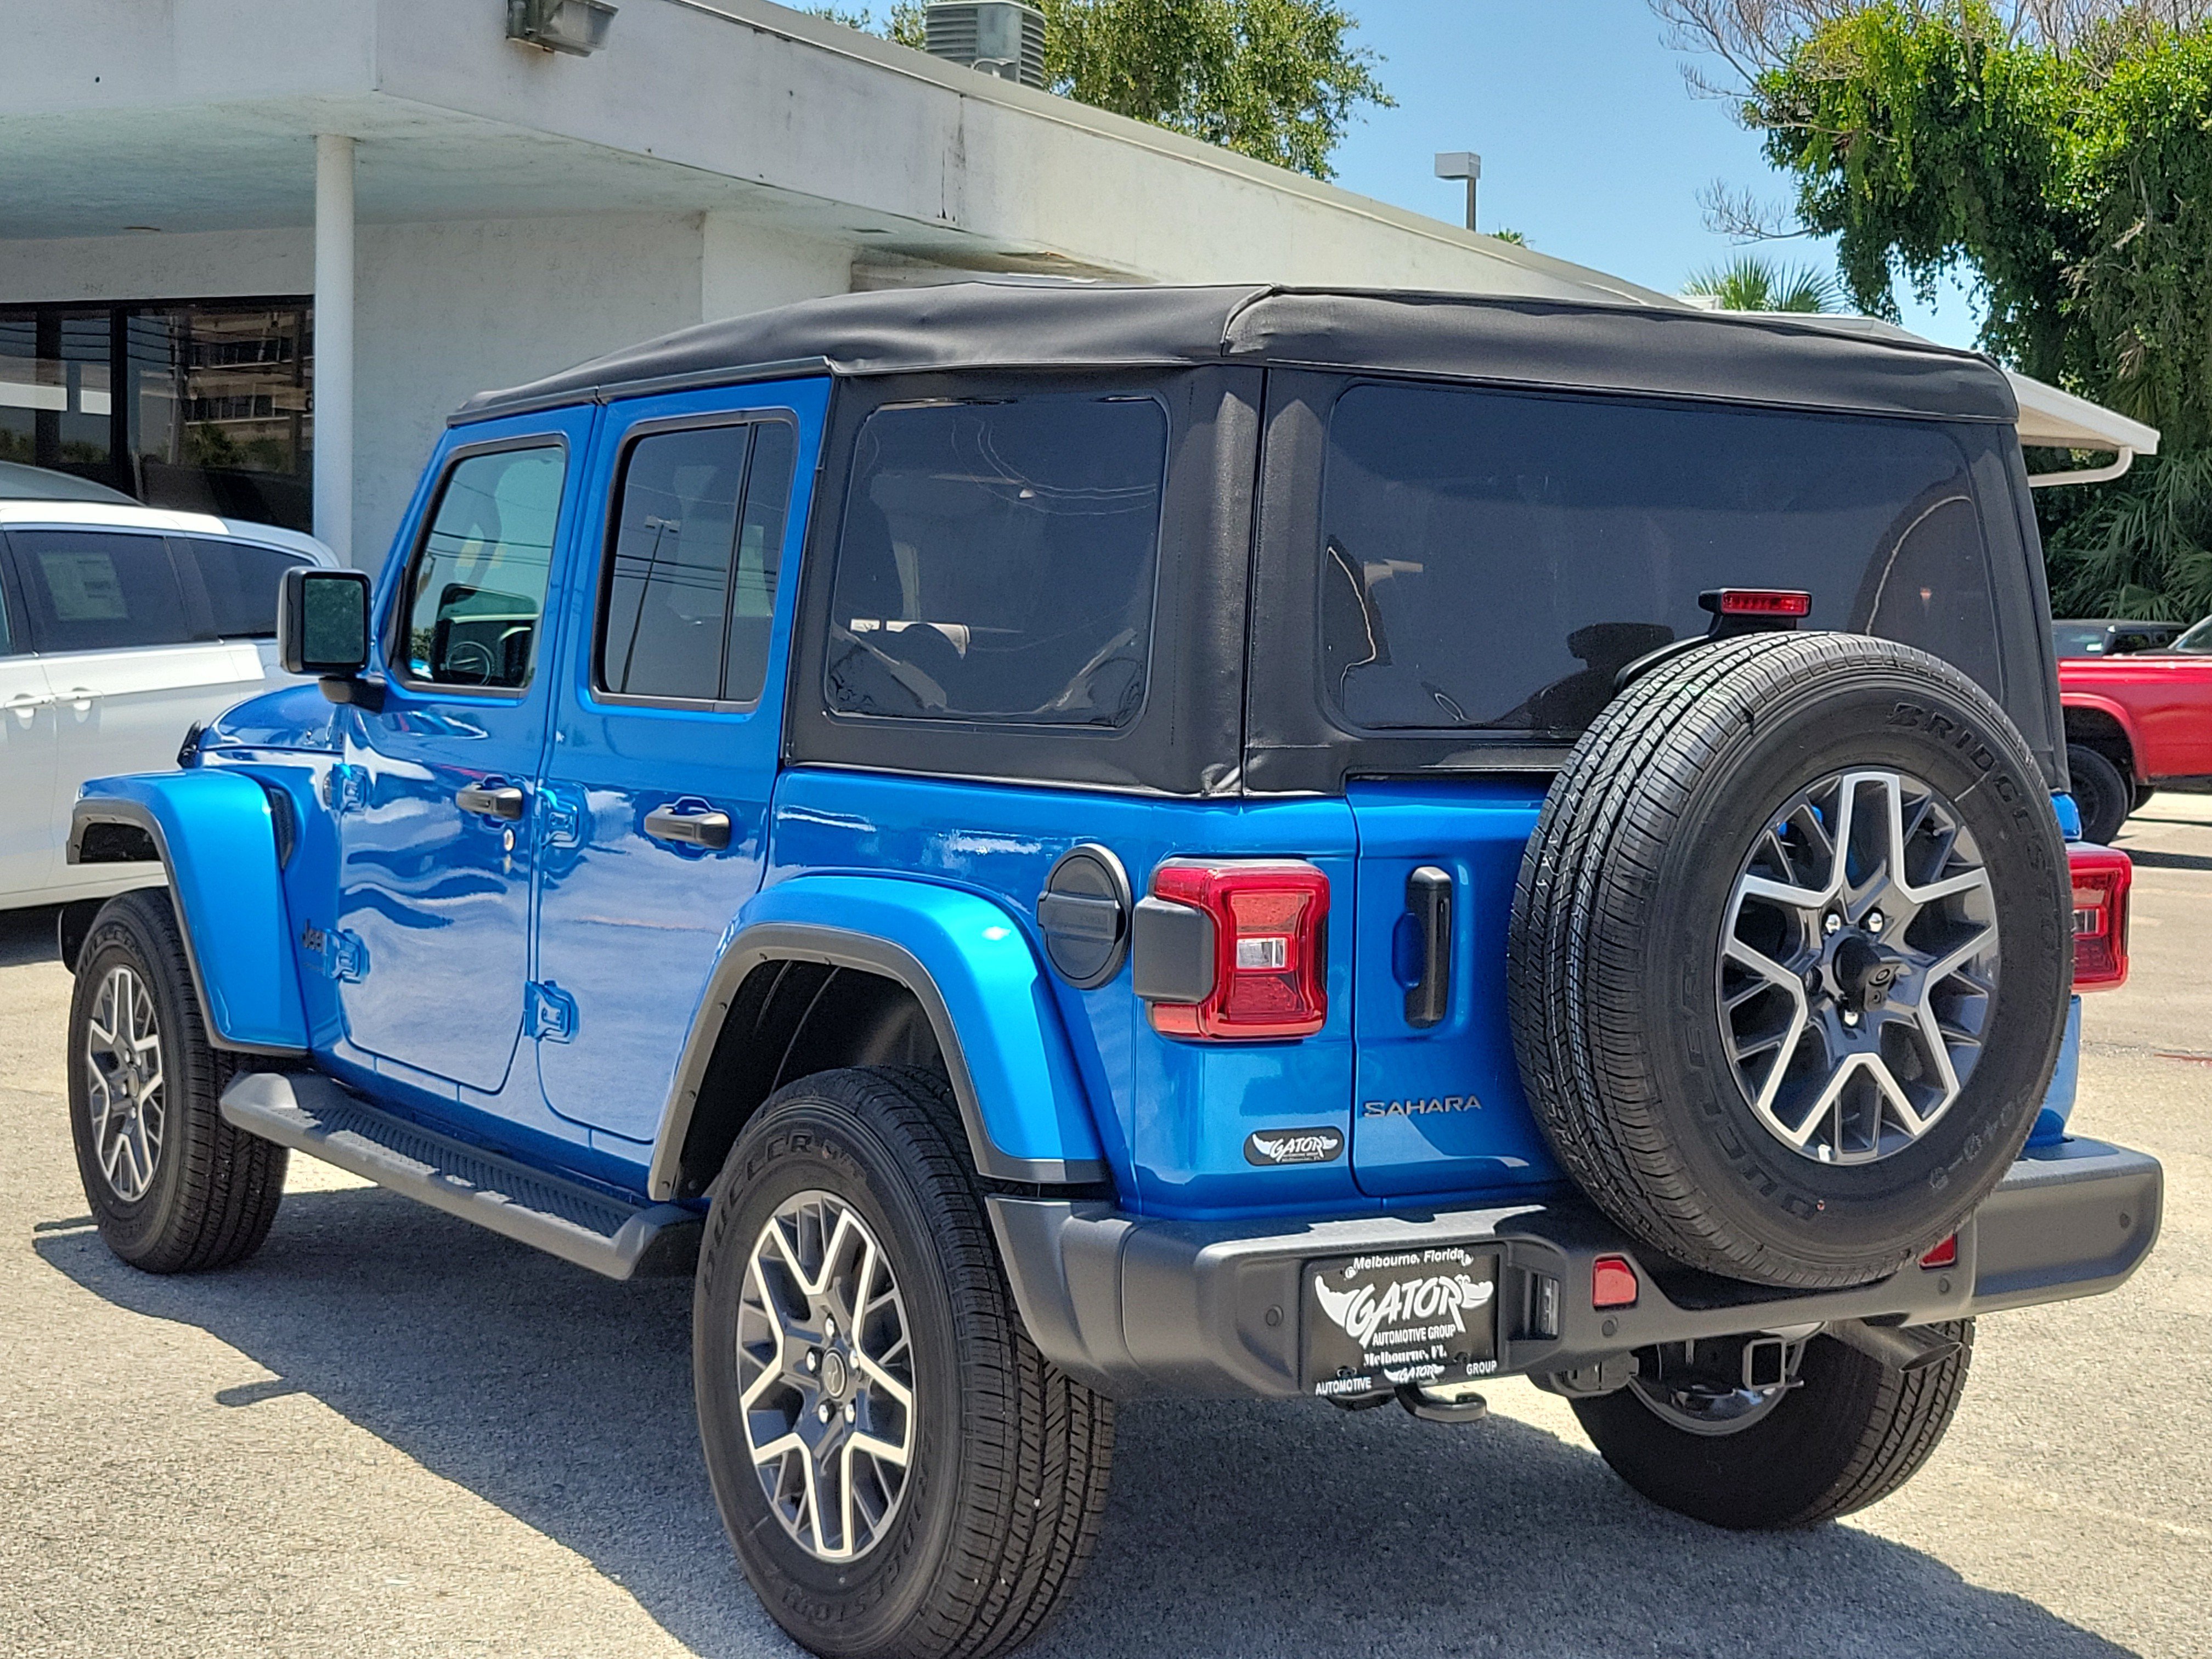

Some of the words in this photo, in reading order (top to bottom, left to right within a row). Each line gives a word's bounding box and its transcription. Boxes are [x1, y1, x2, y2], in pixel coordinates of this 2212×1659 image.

[302, 918, 323, 953] Jee
[1364, 1096, 1481, 1118] SAHARA
[1270, 1137, 1324, 1163] GATOR
[1353, 1252, 1420, 1270] Melbourne,
[1424, 1248, 1464, 1263] Florida
[1346, 1276, 1466, 1348] GATOR
[1372, 1327, 1426, 1346] AUTOMOTIVE
[1427, 1324, 1456, 1339] GROUP
[1315, 1377, 1372, 1395] AUTOMOTIVE
[1398, 1365, 1436, 1383] GATOR
[1466, 1361, 1497, 1376] GROUP
